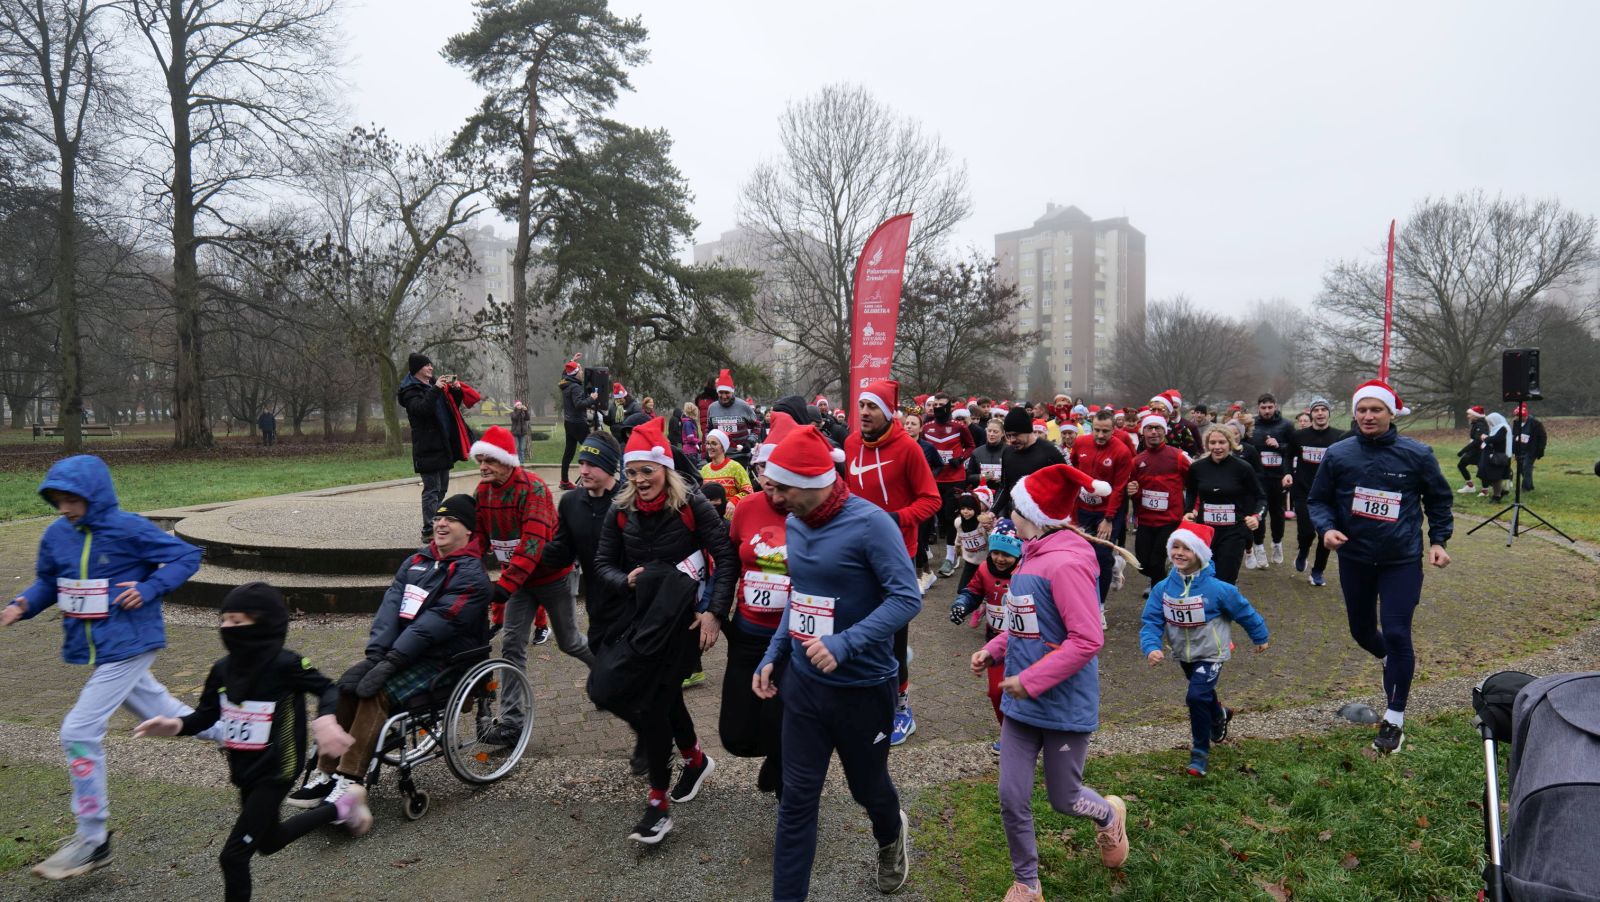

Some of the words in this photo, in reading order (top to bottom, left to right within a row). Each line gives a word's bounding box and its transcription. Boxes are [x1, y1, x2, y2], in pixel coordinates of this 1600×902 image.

[1149, 500, 1159, 508] 43
[1364, 501, 1389, 516] 189
[1211, 513, 1228, 522] 164
[965, 539, 980, 548] 116
[752, 589, 771, 606] 28
[1170, 609, 1193, 622] 191
[800, 613, 815, 635] 30
[990, 616, 1004, 629] 77
